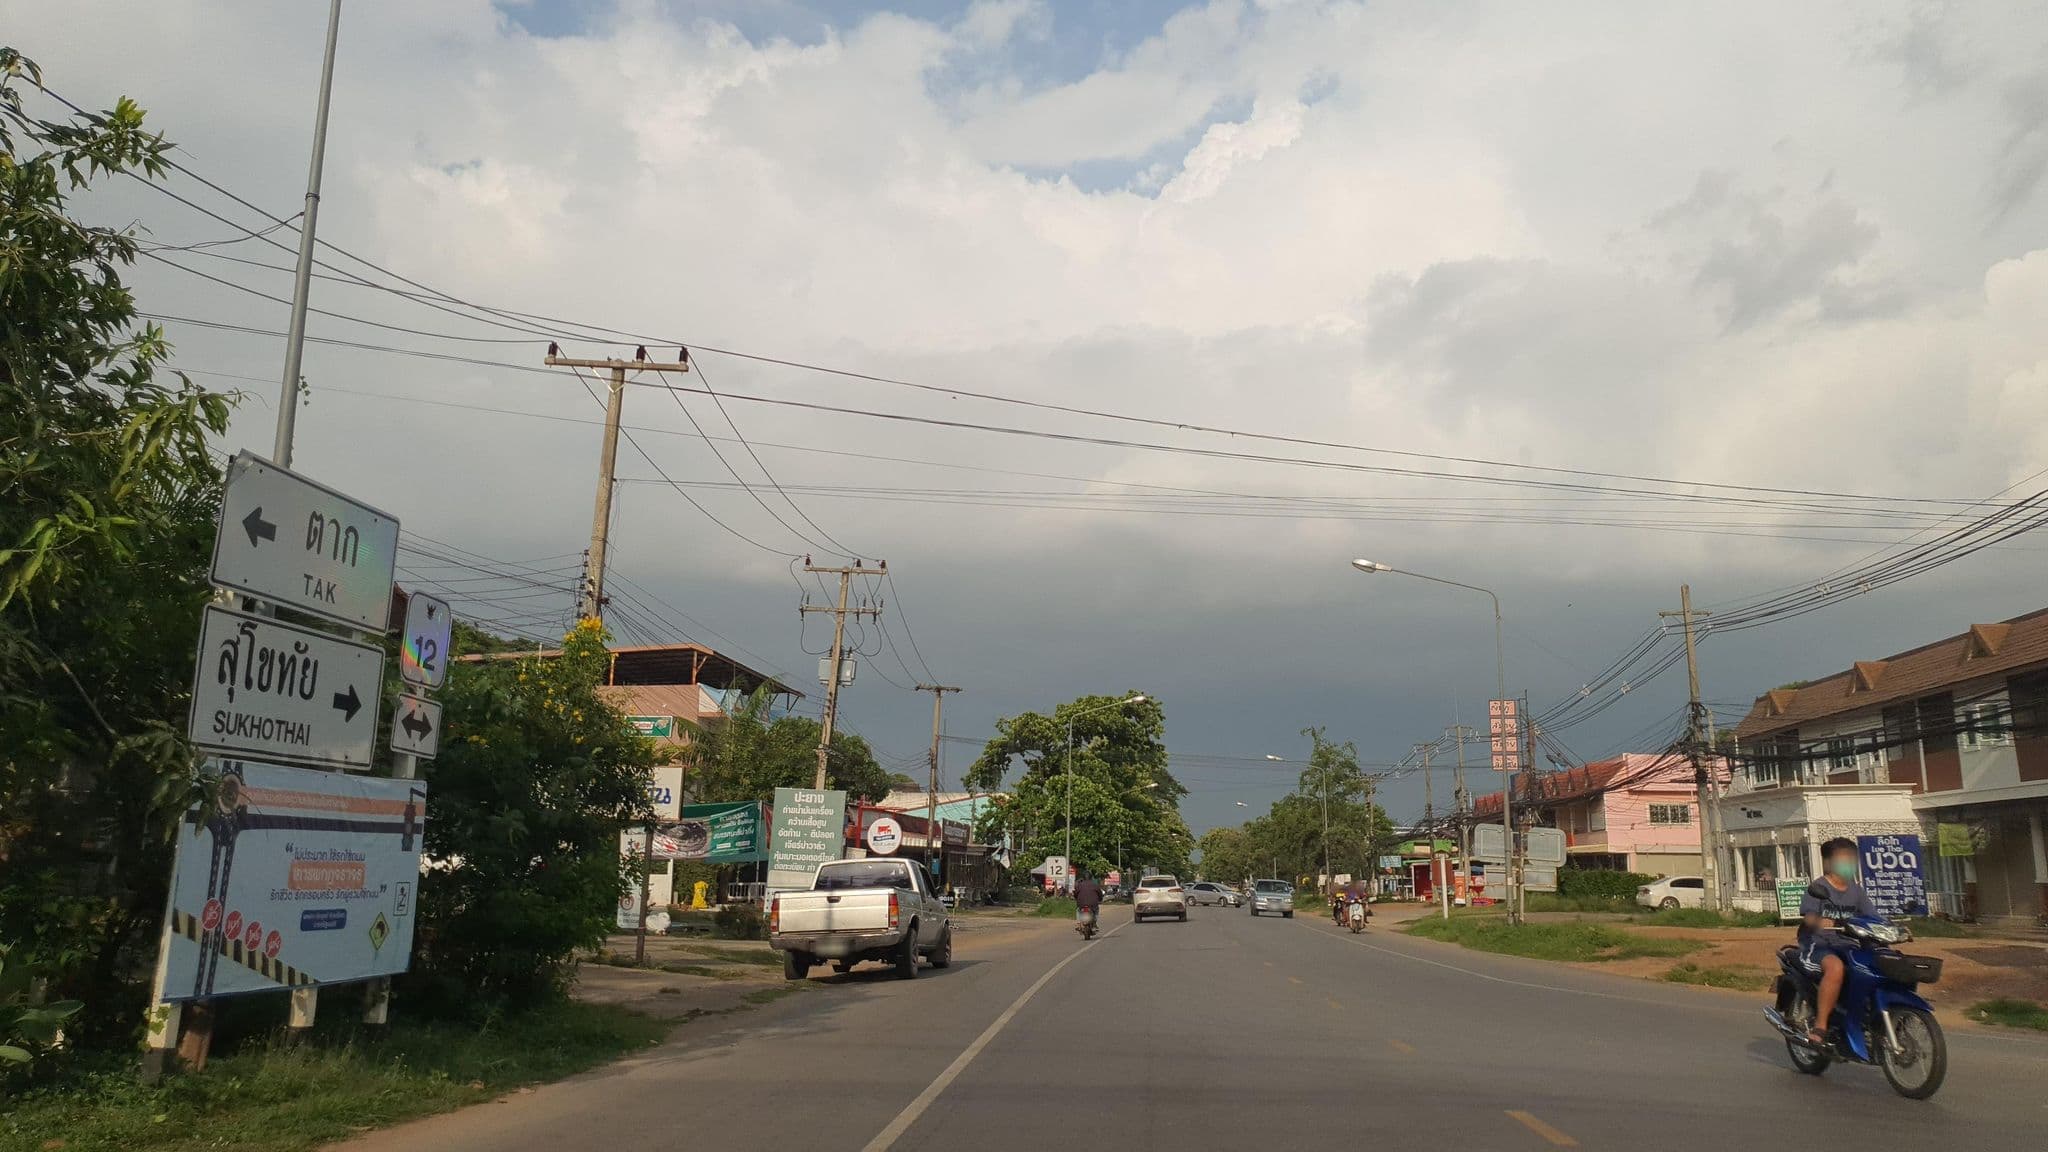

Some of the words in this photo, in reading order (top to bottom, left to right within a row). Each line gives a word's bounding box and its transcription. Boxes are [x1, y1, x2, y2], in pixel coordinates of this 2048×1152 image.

[305, 510, 360, 568] ตาก
[303, 573, 337, 604] TAK
[217, 620, 319, 704] สุโขทัย
[415, 635, 438, 672] 12
[212, 709, 312, 746] SUKHOTHAI
[783, 804, 834, 815] ถ่ายน้ำมันเครื่อง
[794, 791, 824, 804] ปะยาง
[1050, 866, 1063, 875] 12
[1865, 851, 1917, 870] นวด
